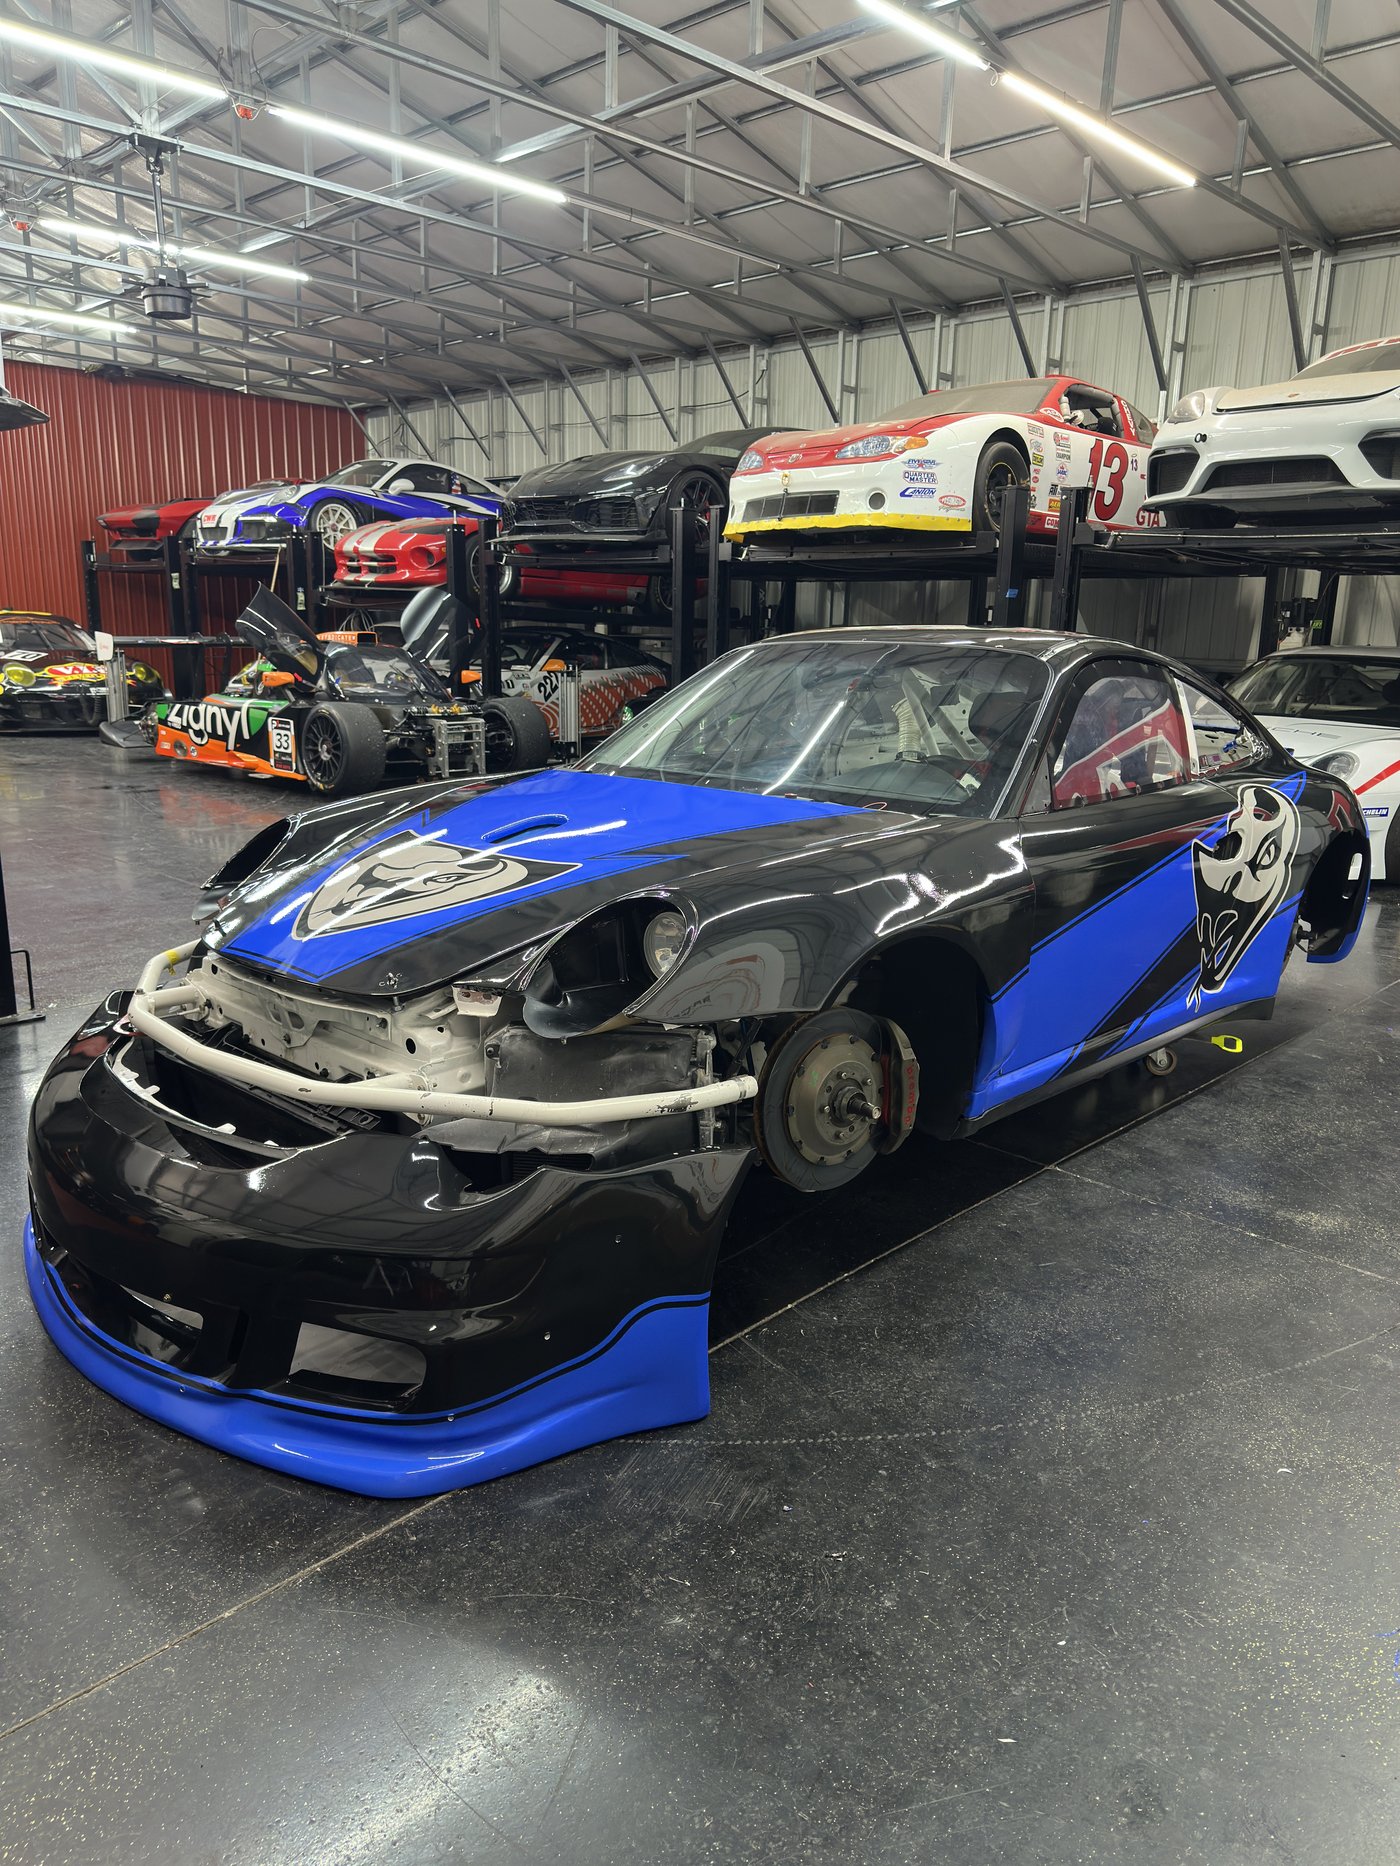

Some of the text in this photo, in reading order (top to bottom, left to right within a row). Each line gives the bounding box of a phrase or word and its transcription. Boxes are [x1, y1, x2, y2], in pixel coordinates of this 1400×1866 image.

[1120, 400, 1136, 436] CHEVY
[1130, 457, 1138, 472] 13
[903, 471, 935, 479] QUARTER
[1086, 438, 1129, 521] 13
[899, 486, 937, 498] CANTON
[8, 650, 42, 659] 70
[275, 732, 290, 750] 33
[1362, 808, 1388, 816] CHELIN
